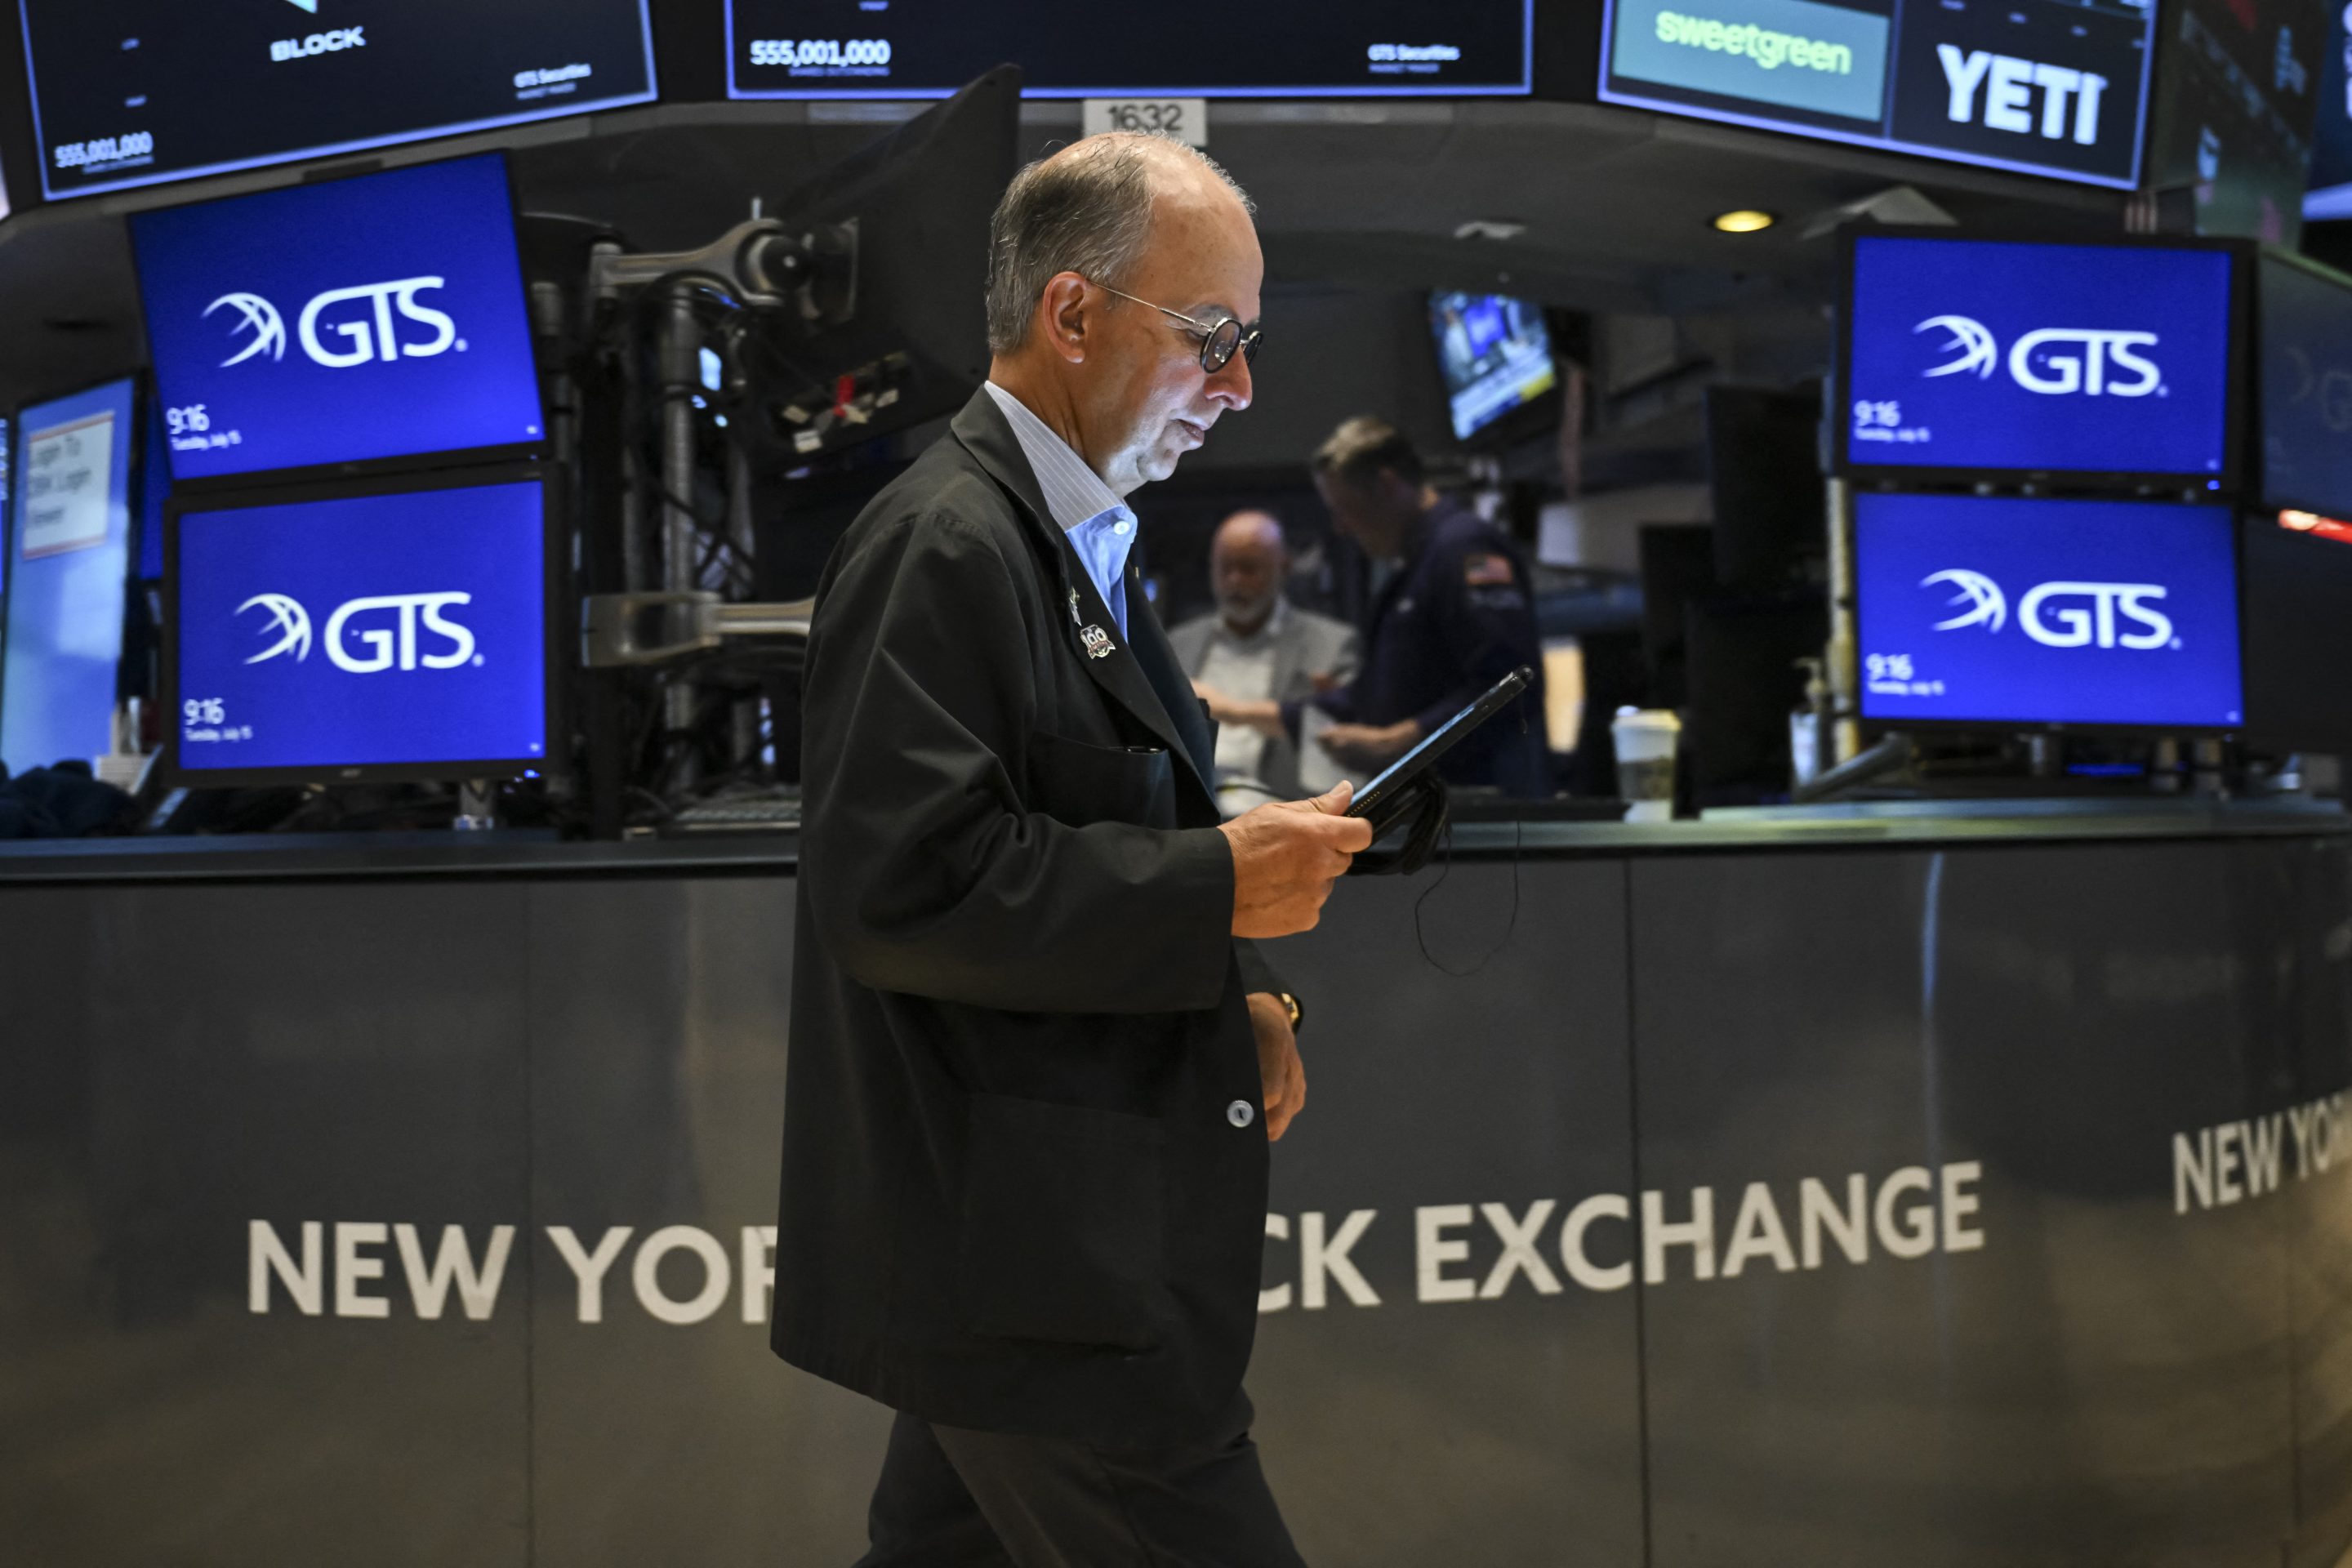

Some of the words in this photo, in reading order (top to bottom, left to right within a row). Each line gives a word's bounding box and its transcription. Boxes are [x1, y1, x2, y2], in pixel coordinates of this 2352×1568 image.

[270, 26, 366, 61] BLOCK
[751, 39, 891, 67] 555,001,000
[1656, 11, 1852, 74] sweetgreen
[1108, 104, 1183, 131] 1632
[1936, 43, 2107, 145] YETI
[298, 275, 455, 368] GTS
[2009, 328, 2161, 396] GTS
[324, 591, 474, 673] GTS
[2018, 581, 2173, 649] GTS
[2173, 1116, 2283, 1216] NEW
[249, 1220, 516, 1321] NEW
[1415, 1161, 1985, 1304] EXCHANGE
